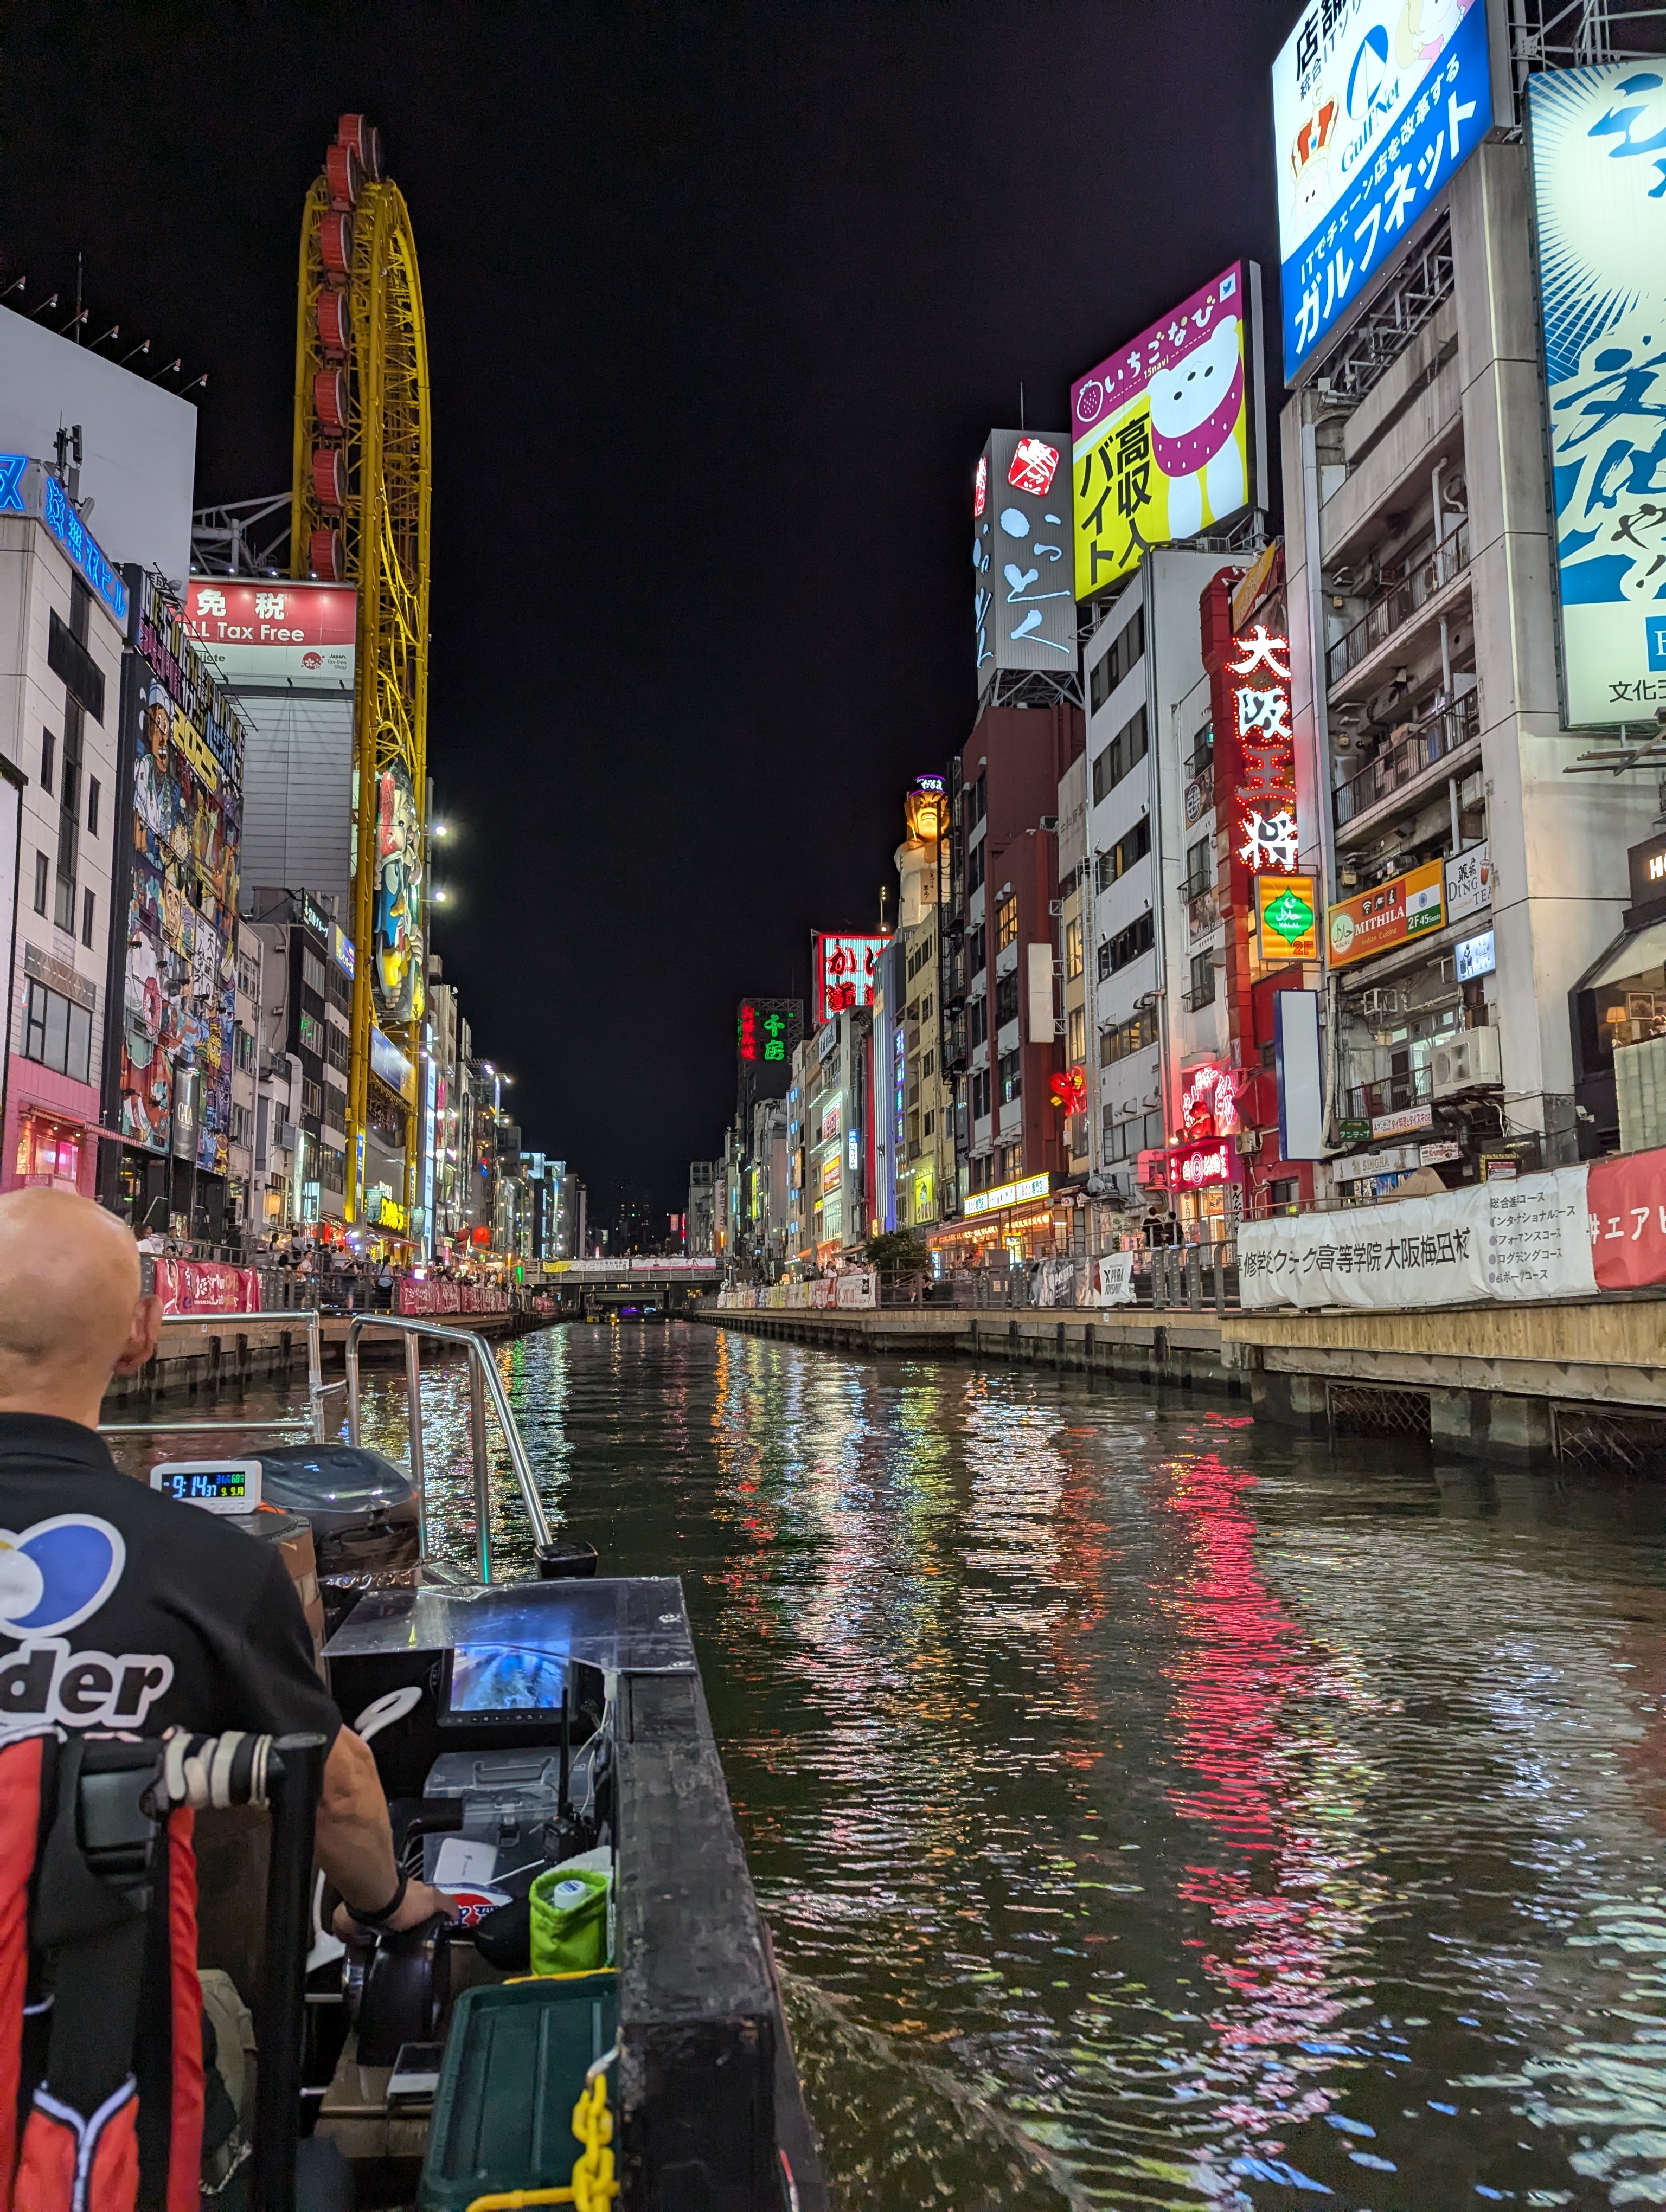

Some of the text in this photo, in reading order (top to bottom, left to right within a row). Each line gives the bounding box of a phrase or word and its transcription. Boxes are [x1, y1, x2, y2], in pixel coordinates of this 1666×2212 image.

[1342, 76, 1400, 172] GulfNet
[1301, 53, 1460, 284] ITでチェーン店を改革する
[1295, 90, 1476, 355] ガルフネット
[1104, 294, 1216, 394] いちごなび
[1143, 353, 1170, 380] 15navi
[1116, 411, 1152, 569] 高収入
[1079, 435, 1113, 586] バイト
[196, 589, 285, 620] 免税
[217, 622, 254, 639] Tax
[260, 624, 305, 642] Free
[173, 703, 218, 793] 2025
[1229, 625, 1299, 871] 大阪王将
[921, 779, 943, 791] だるま
[1650, 853, 1666, 880] H
[1448, 876, 1478, 903] DING
[1354, 906, 1405, 936] MITHILA
[1408, 915, 1419, 930] 2F
[1293, 941, 1314, 955] 2F
[1335, 940, 1350, 949] HALAL
[1362, 927, 1397, 946] Indian Cuisine
[764, 1014, 785, 1060] 千房
[1362, 1155, 1389, 1171] SINGHA
[172, 1475, 217, 1499] 9:14 37
